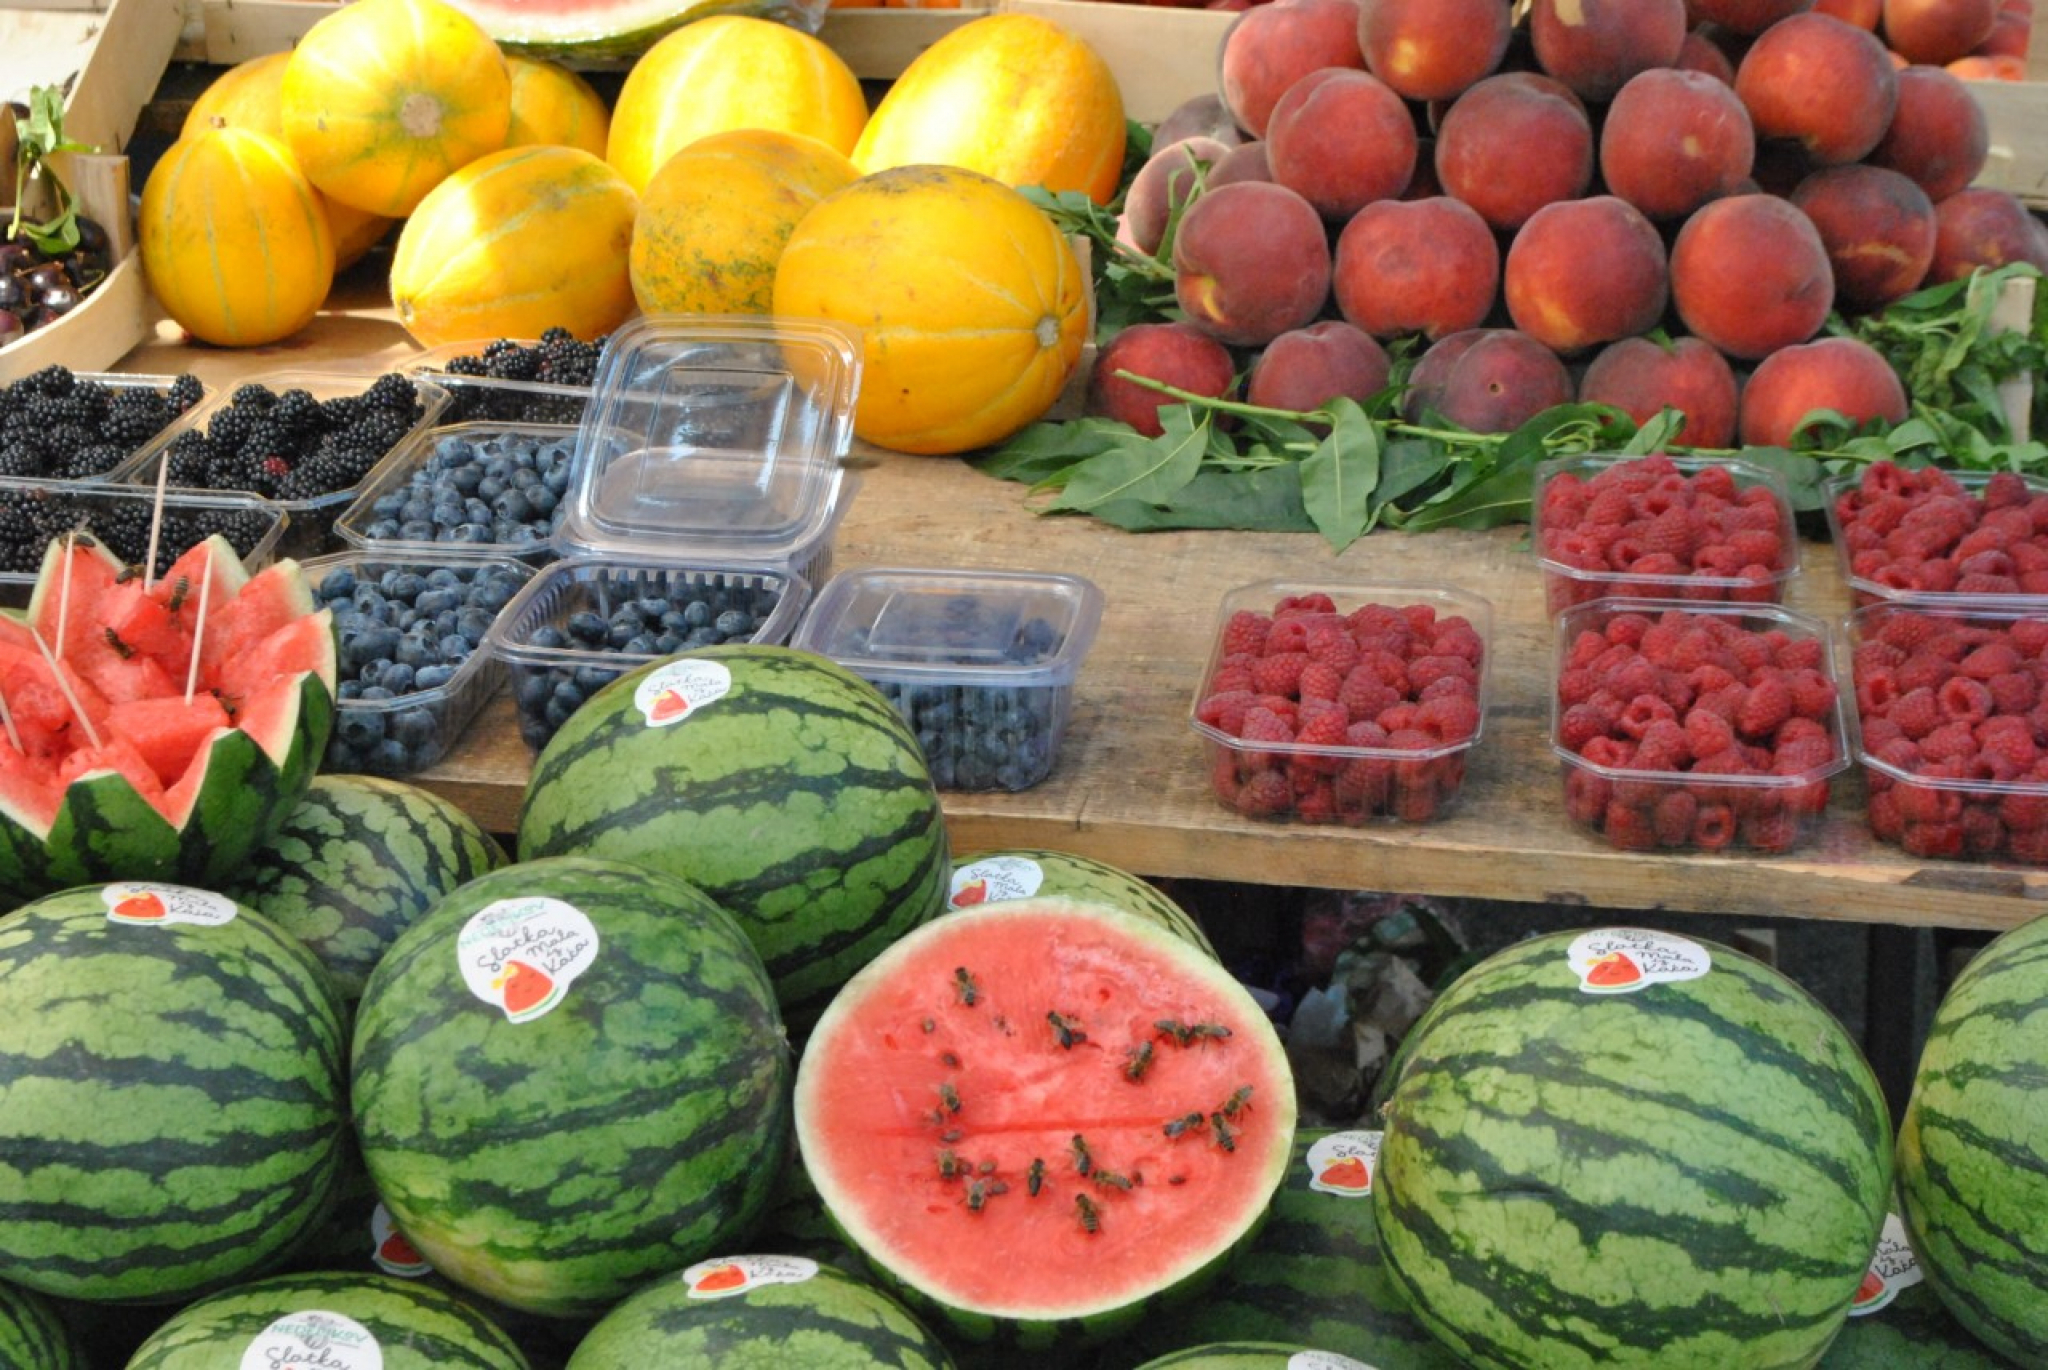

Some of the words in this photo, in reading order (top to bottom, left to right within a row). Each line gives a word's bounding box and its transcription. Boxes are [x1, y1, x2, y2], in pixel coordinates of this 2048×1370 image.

[477, 926, 556, 973] Slatka
[1588, 940, 1677, 956] Slatka
[264, 1346, 352, 1370] Slatka
